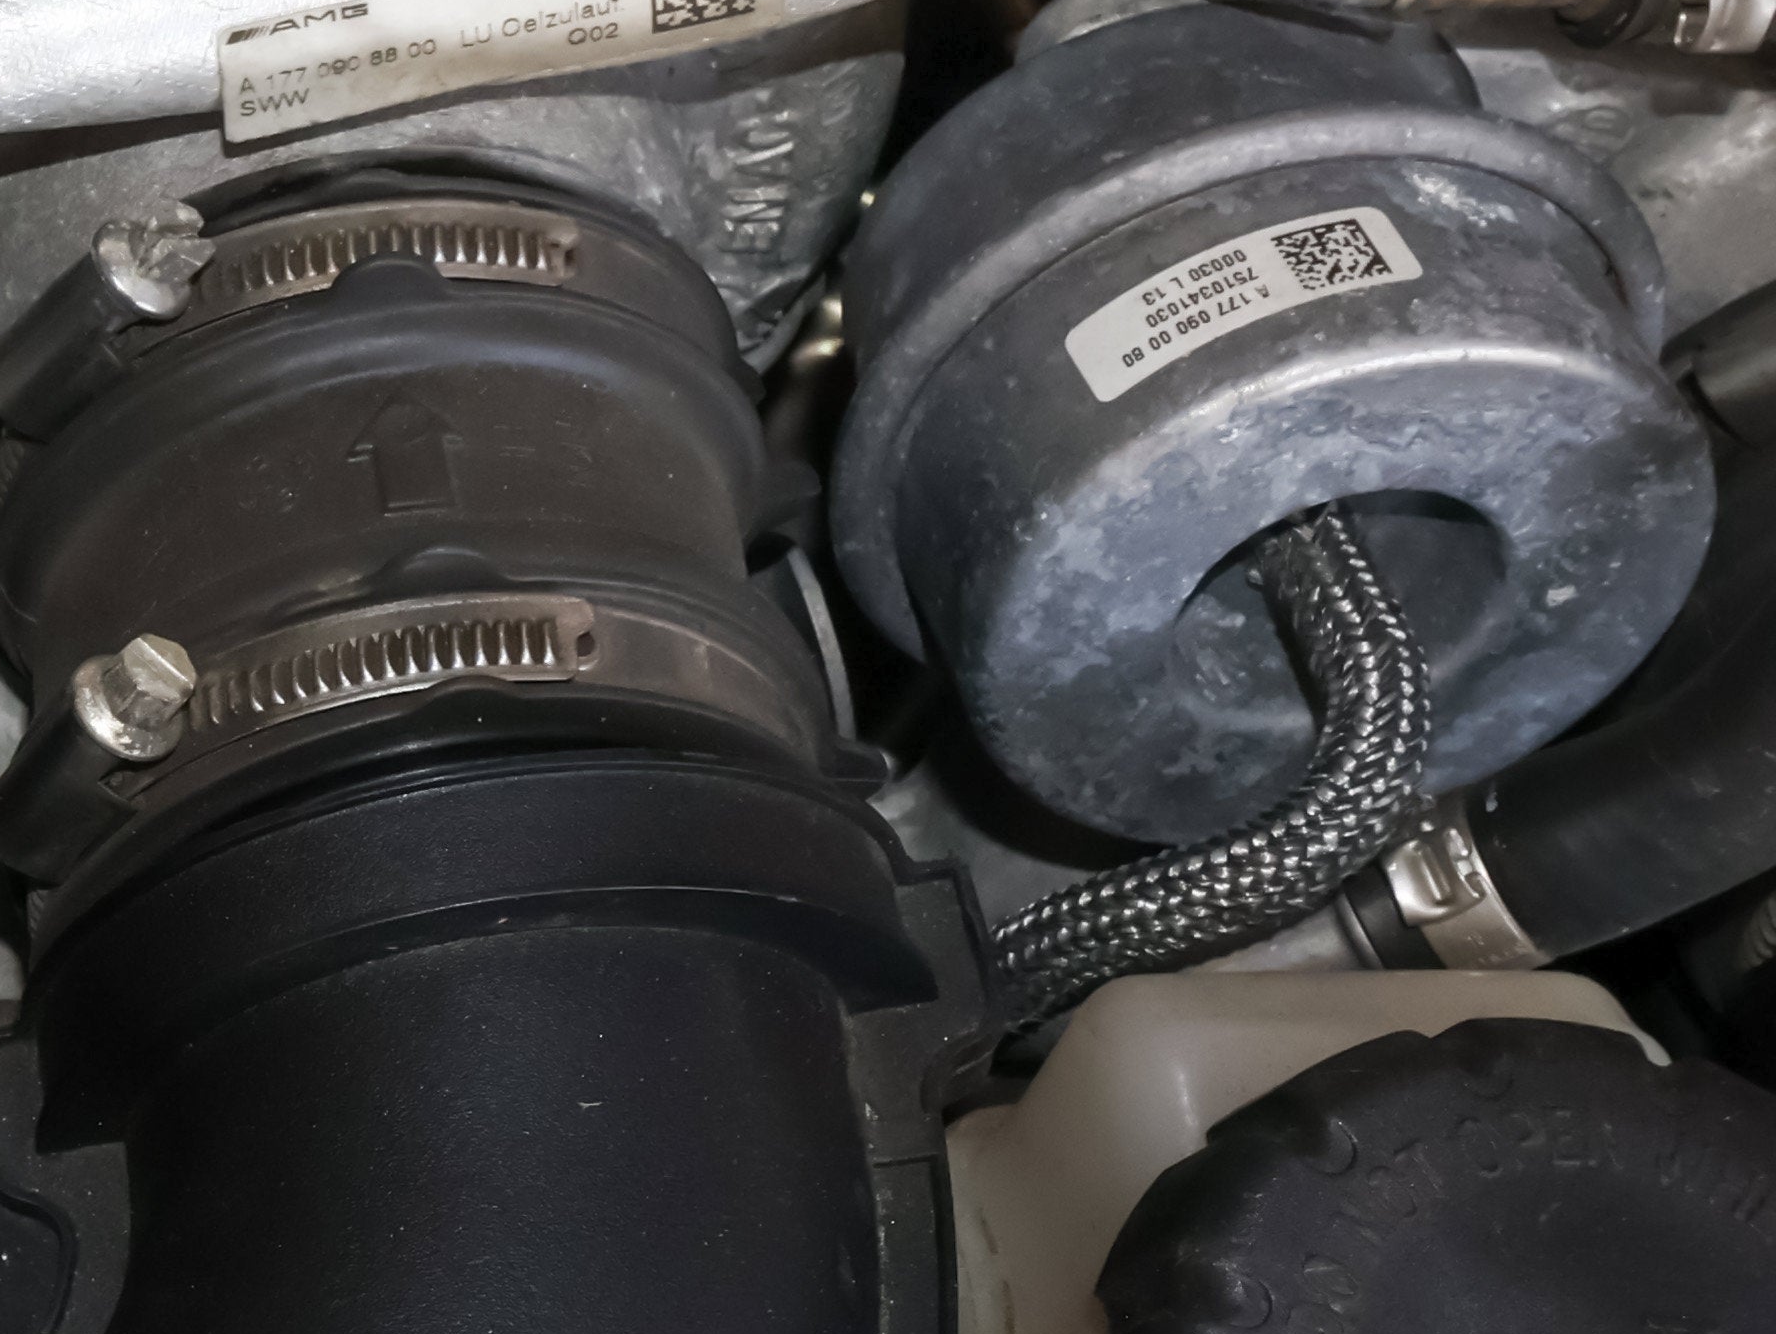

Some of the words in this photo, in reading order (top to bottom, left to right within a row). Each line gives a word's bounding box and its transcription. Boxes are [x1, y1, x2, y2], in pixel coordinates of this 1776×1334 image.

[268, 2, 370, 36] AMG
[239, 77, 256, 96] A
[264, 66, 307, 92] 177
[369, 47, 399, 66] 88
[406, 37, 437, 59] 00
[457, 25, 494, 51] LU
[238, 88, 310, 118] SWW
[1188, 249, 1247, 280] 00030
[1142, 285, 1166, 306] 13
[1146, 266, 1258, 328] 7510341030
[1218, 293, 1252, 317] 177
[1175, 310, 1212, 336] 090
[1147, 328, 1172, 352] 00
